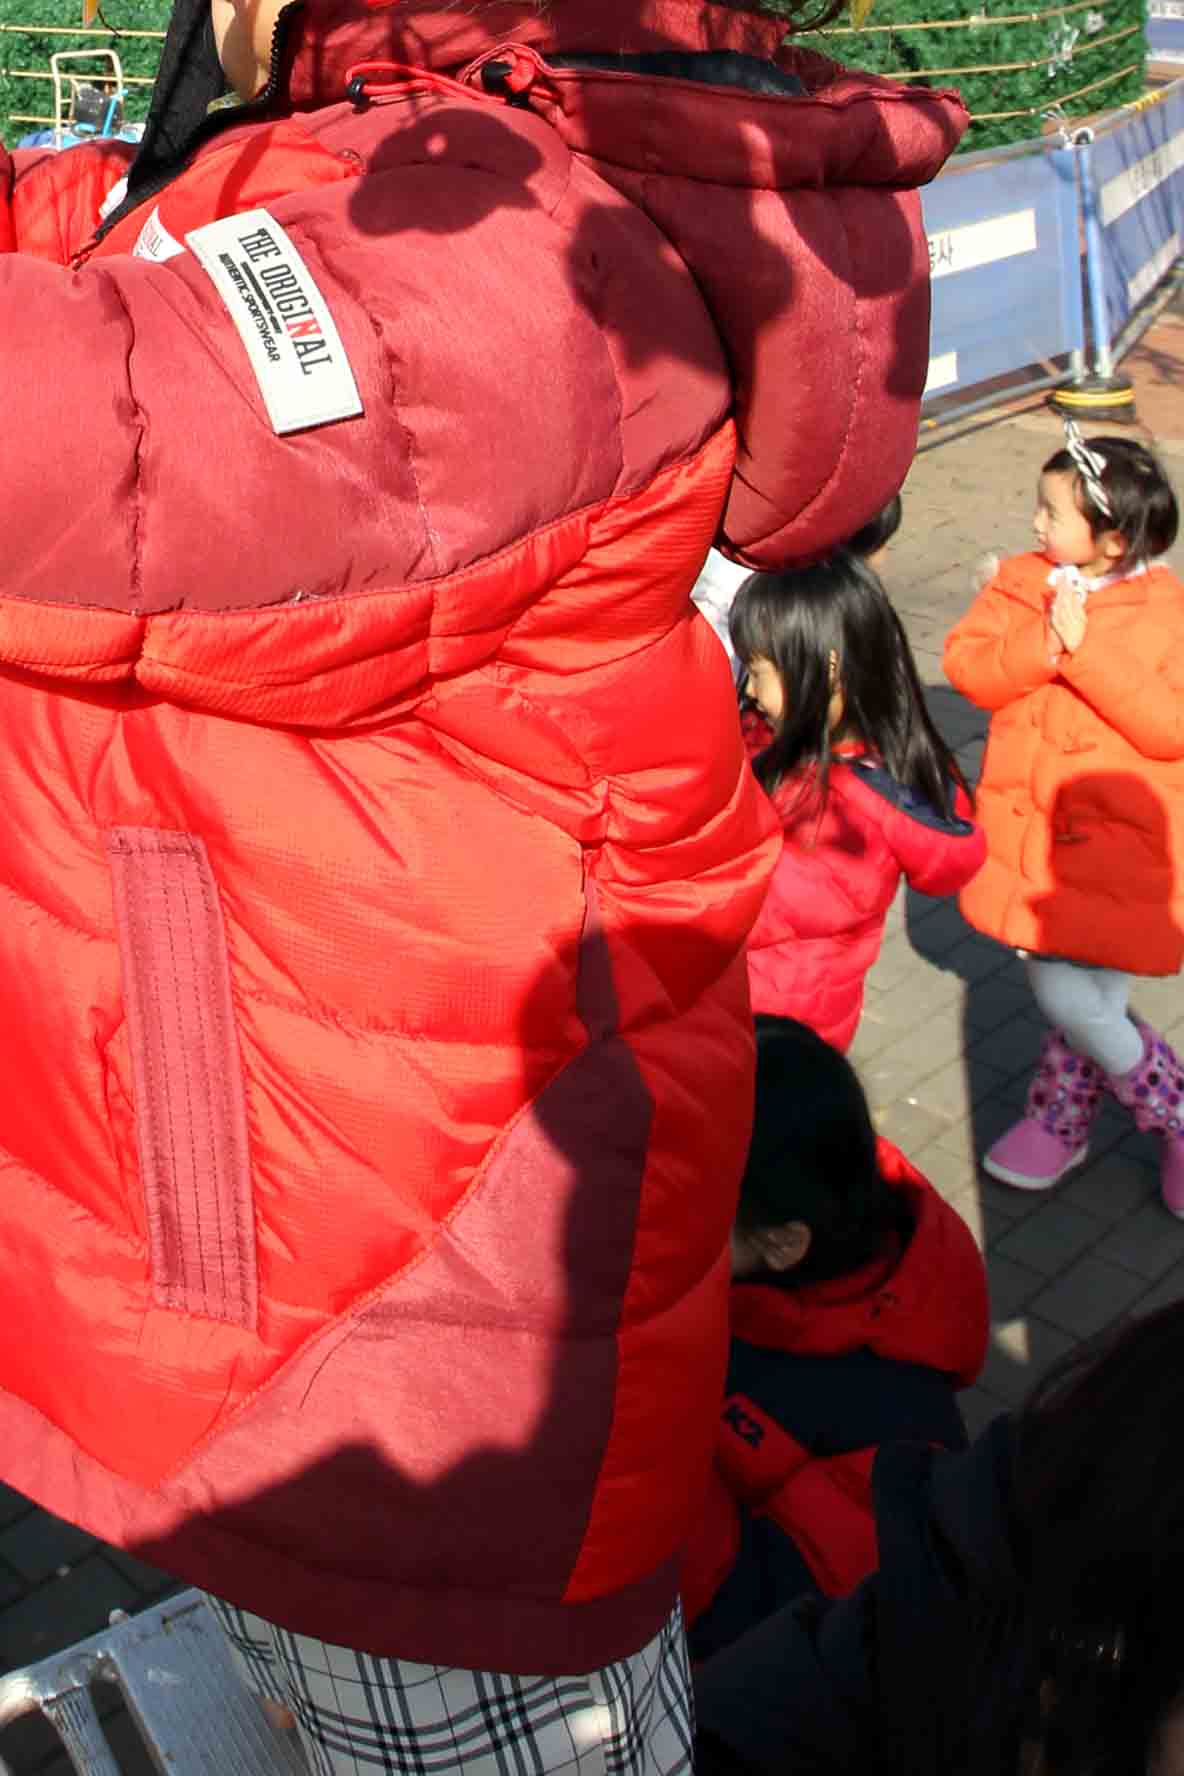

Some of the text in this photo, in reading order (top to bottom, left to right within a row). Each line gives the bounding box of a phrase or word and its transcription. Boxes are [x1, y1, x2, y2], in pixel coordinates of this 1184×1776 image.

[218, 253, 250, 294] AUTHENTIC
[242, 294, 281, 362] SPORTSWEAR
[238, 228, 282, 263] THE
[260, 264, 333, 375] ORIGINAL
[722, 1403, 764, 1448] K2
